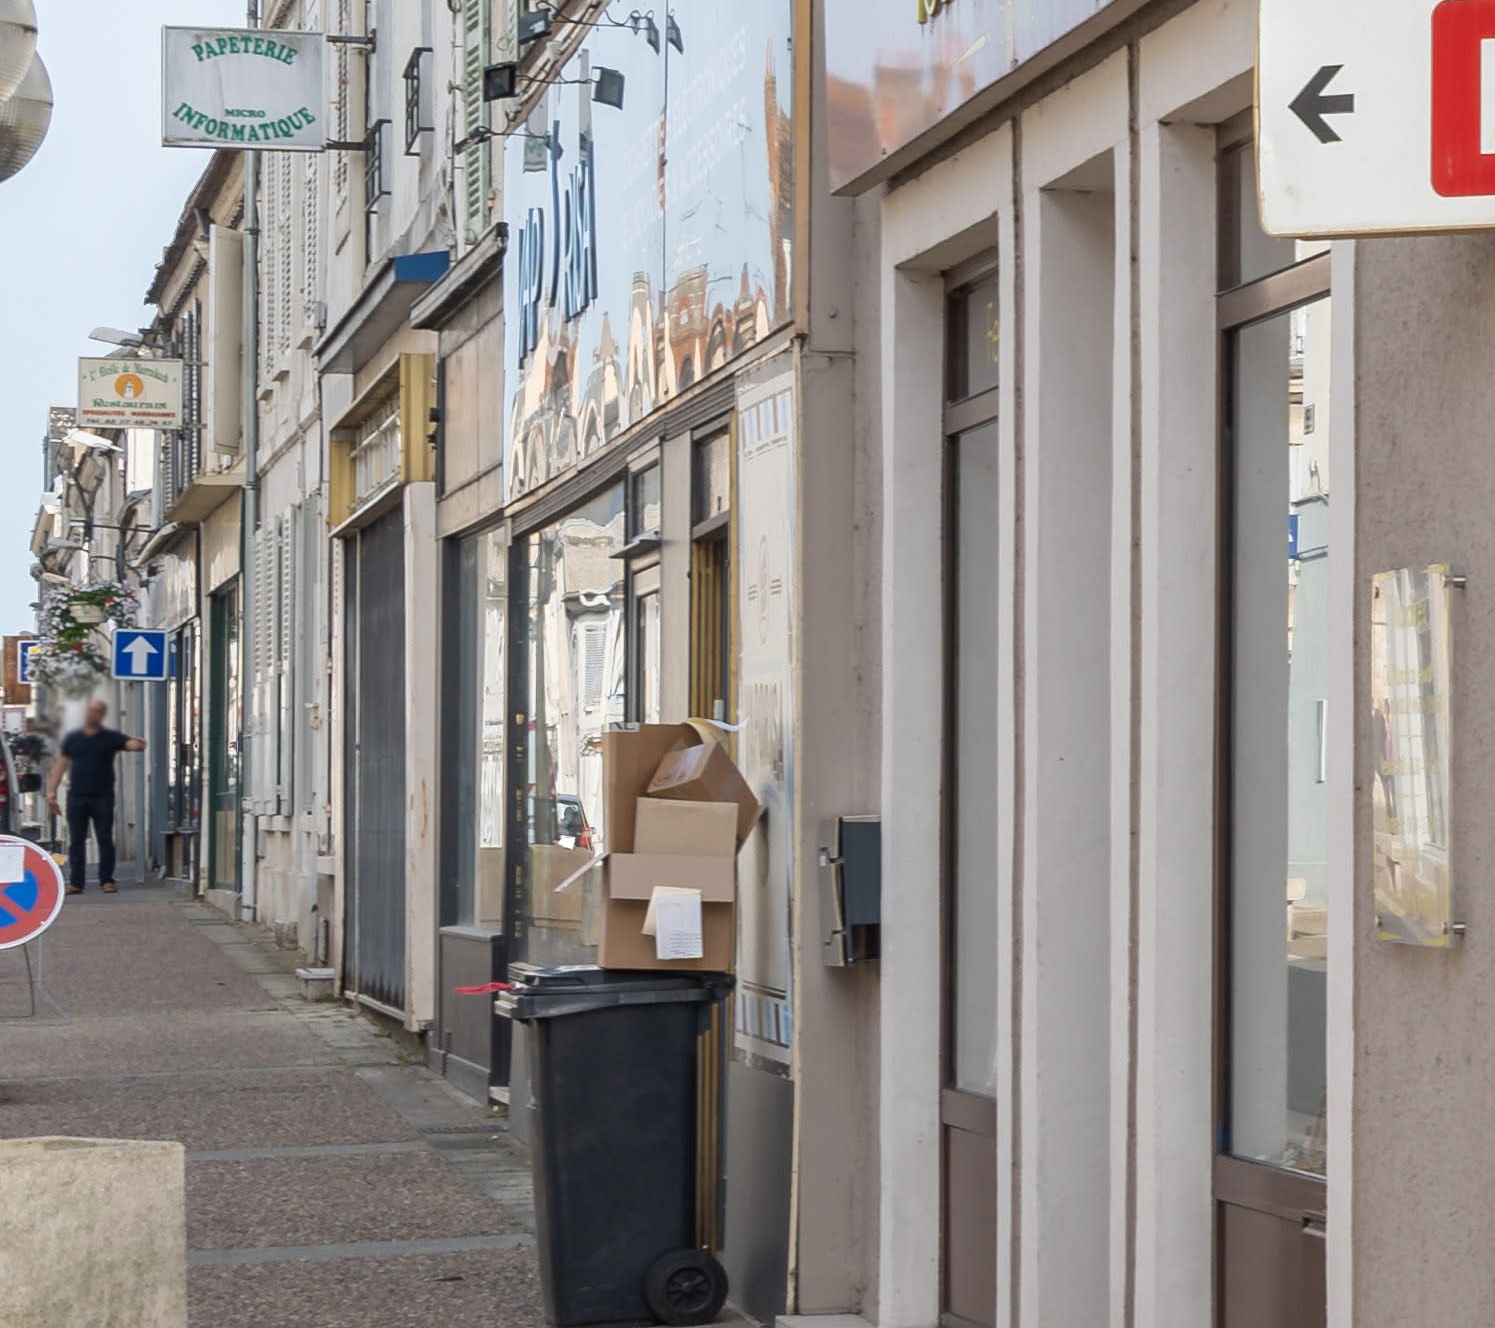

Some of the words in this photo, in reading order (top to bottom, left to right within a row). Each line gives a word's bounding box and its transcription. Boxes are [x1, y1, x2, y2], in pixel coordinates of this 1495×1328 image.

[191, 36, 298, 66] PAPETERIE
[172, 102, 316, 142] INFORMATIQUE
[224, 109, 266, 119] MICRO
